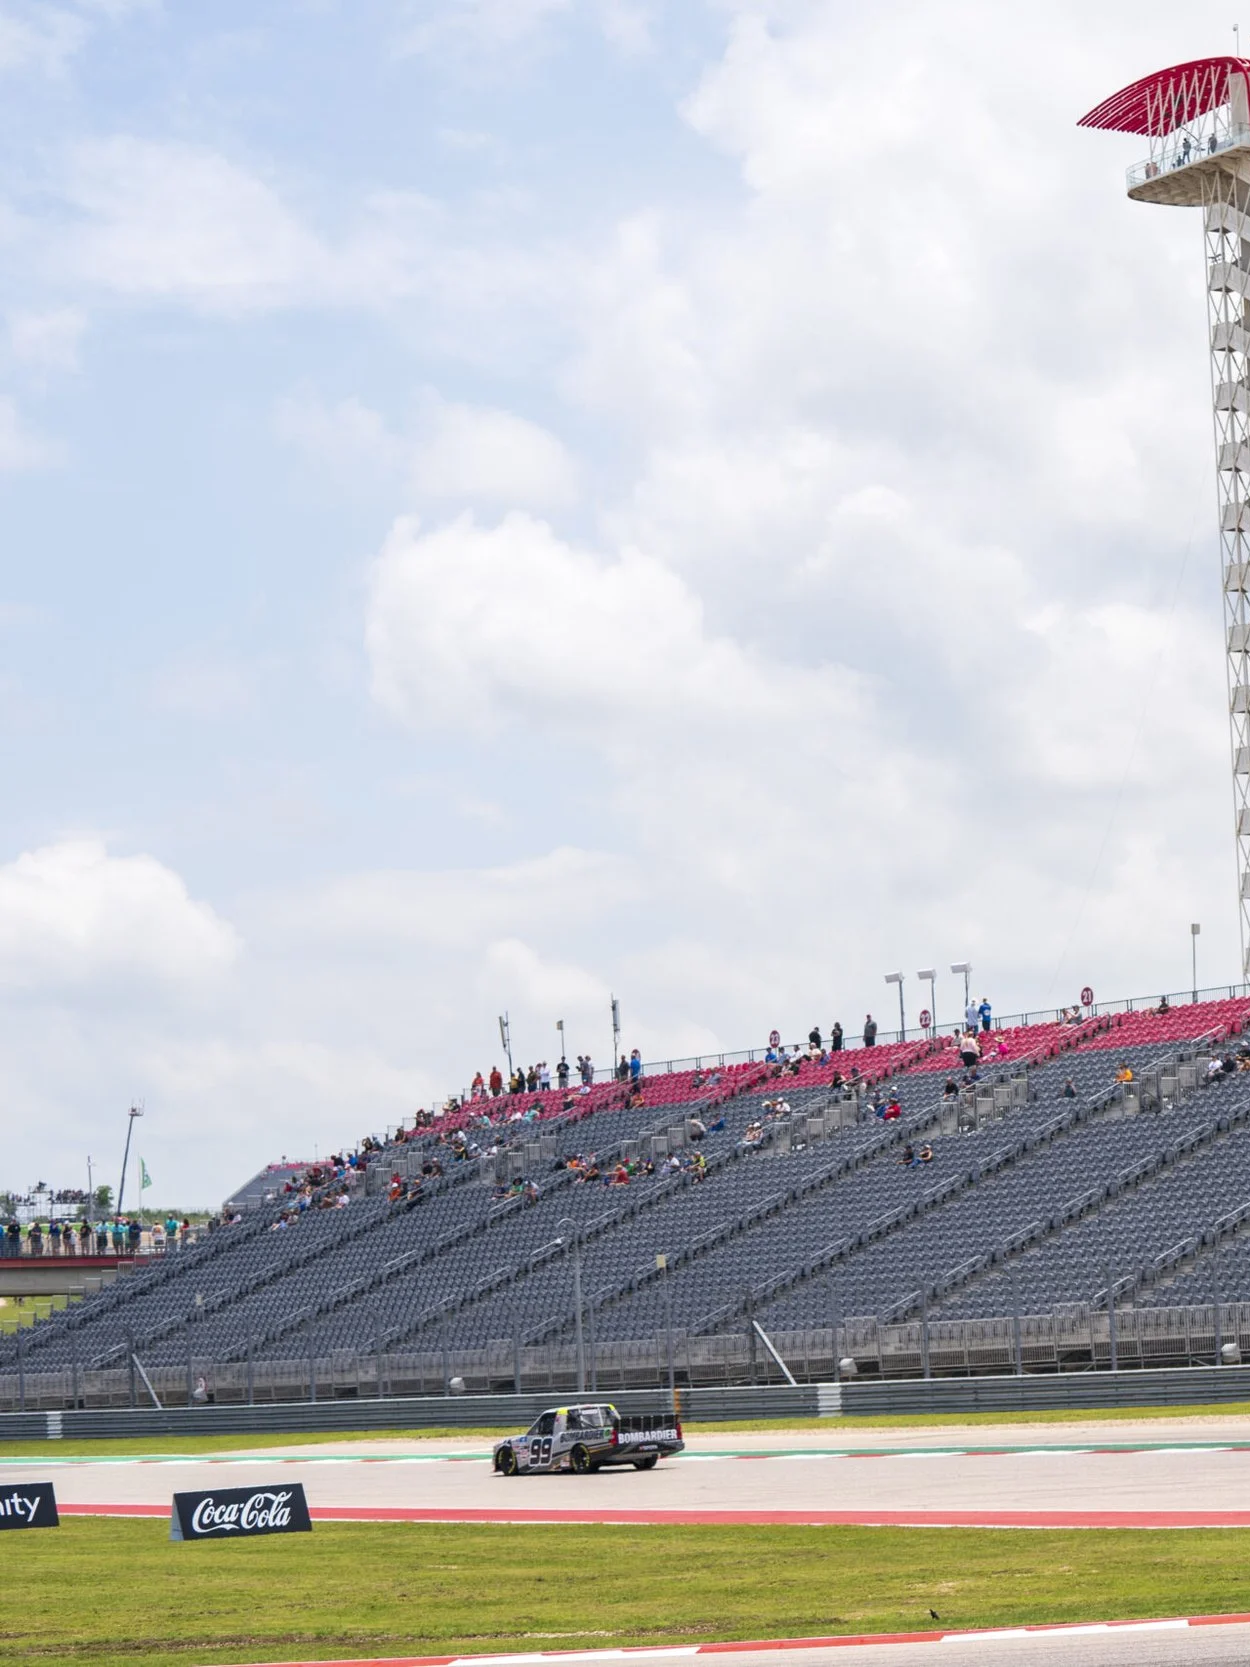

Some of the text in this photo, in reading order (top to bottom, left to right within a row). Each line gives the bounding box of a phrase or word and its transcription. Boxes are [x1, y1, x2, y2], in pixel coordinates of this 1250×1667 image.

[1082, 990, 1092, 1003] 21
[920, 1013, 930, 1024] 22
[618, 1429, 678, 1444] BOMBARDIER
[528, 1436, 553, 1467] 99
[192, 1491, 293, 1533] Coca-Cola
